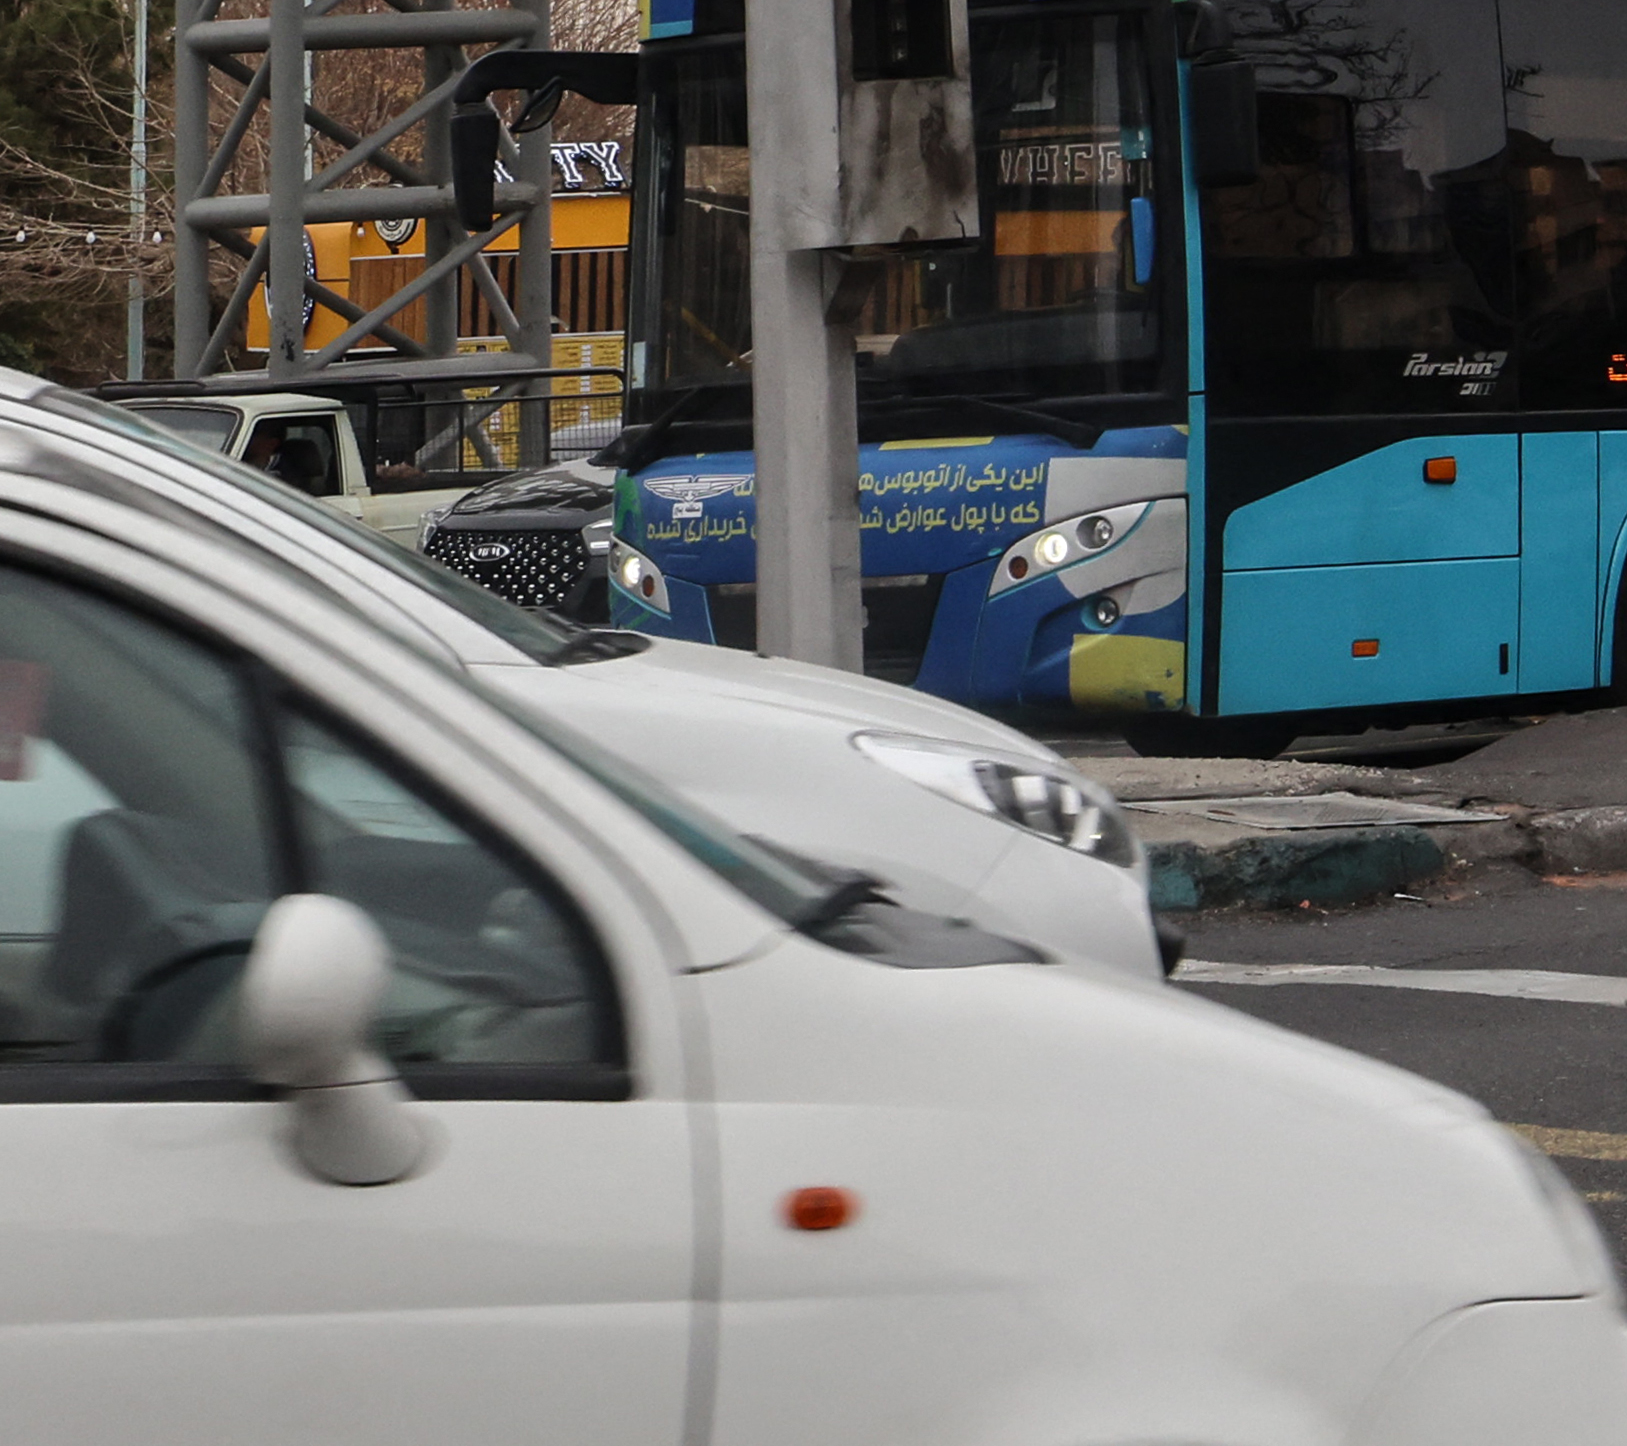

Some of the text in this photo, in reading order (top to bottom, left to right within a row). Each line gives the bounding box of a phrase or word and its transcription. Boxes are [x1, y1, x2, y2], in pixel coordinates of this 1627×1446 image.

[949, 464, 966, 492] از
[965, 463, 1005, 493] یکی
[1009, 462, 1045, 491] این
[684, 511, 748, 543] خریداری
[886, 503, 947, 534] عوارض
[950, 503, 987, 534] پول
[991, 502, 1005, 531] با
[1010, 501, 1040, 524] که
[647, 519, 682, 539] شده
